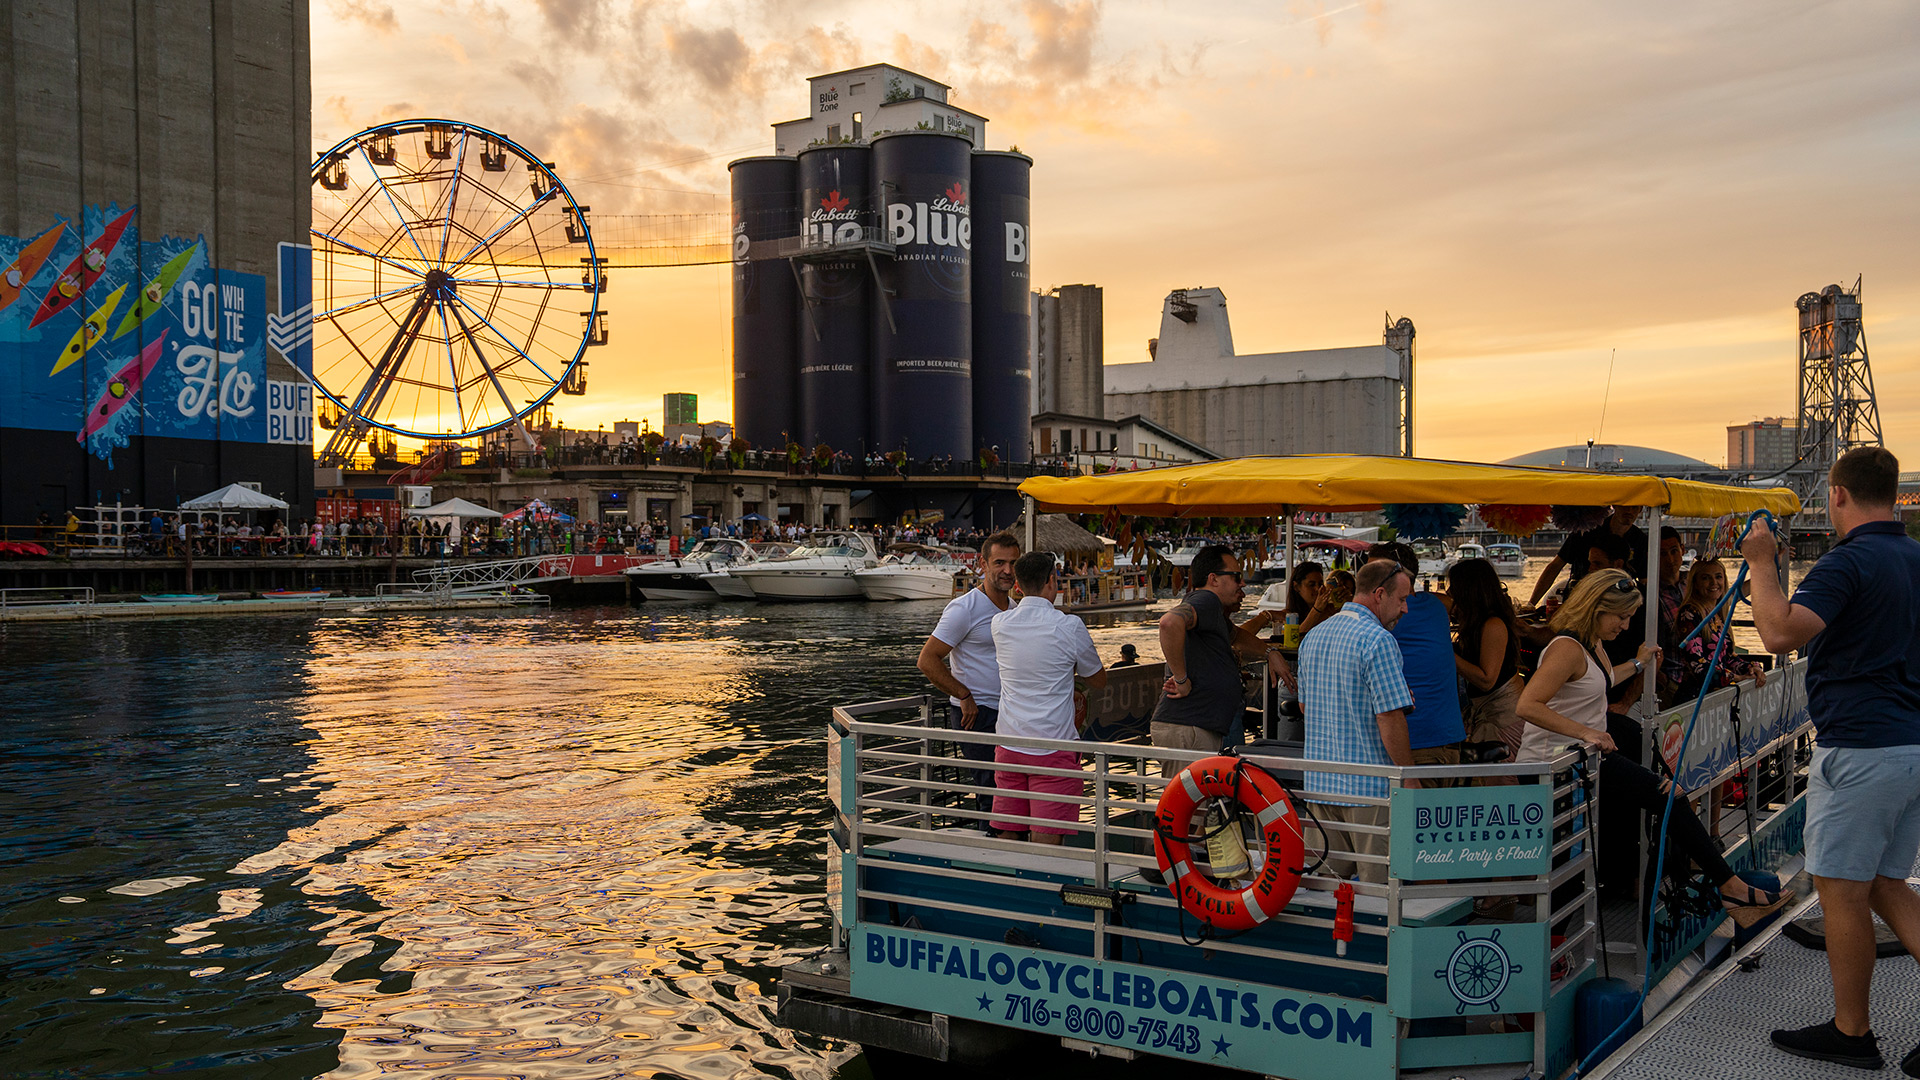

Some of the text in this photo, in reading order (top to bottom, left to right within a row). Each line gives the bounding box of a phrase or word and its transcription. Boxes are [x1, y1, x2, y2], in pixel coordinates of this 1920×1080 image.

[819, 91, 839, 104] Blue
[819, 102, 839, 113] Zone
[810, 206, 858, 223] Labatt
[887, 202, 972, 251] Blue
[801, 217, 864, 250] lue
[893, 253, 936, 262] CANADIAN
[182, 280, 217, 340] GO
[1415, 802, 1544, 829] BUFFALO
[1415, 827, 1544, 844] CYCLEBOATS
[1257, 831, 1282, 897] BOATS
[1415, 844, 1544, 868] Pedal, Party & Float!
[1184, 885, 1236, 916] CYCLE
[866, 932, 1373, 1048] BUFFALOCYCLEBOATS.COM
[1004, 993, 1201, 1055] 716-800-7543
